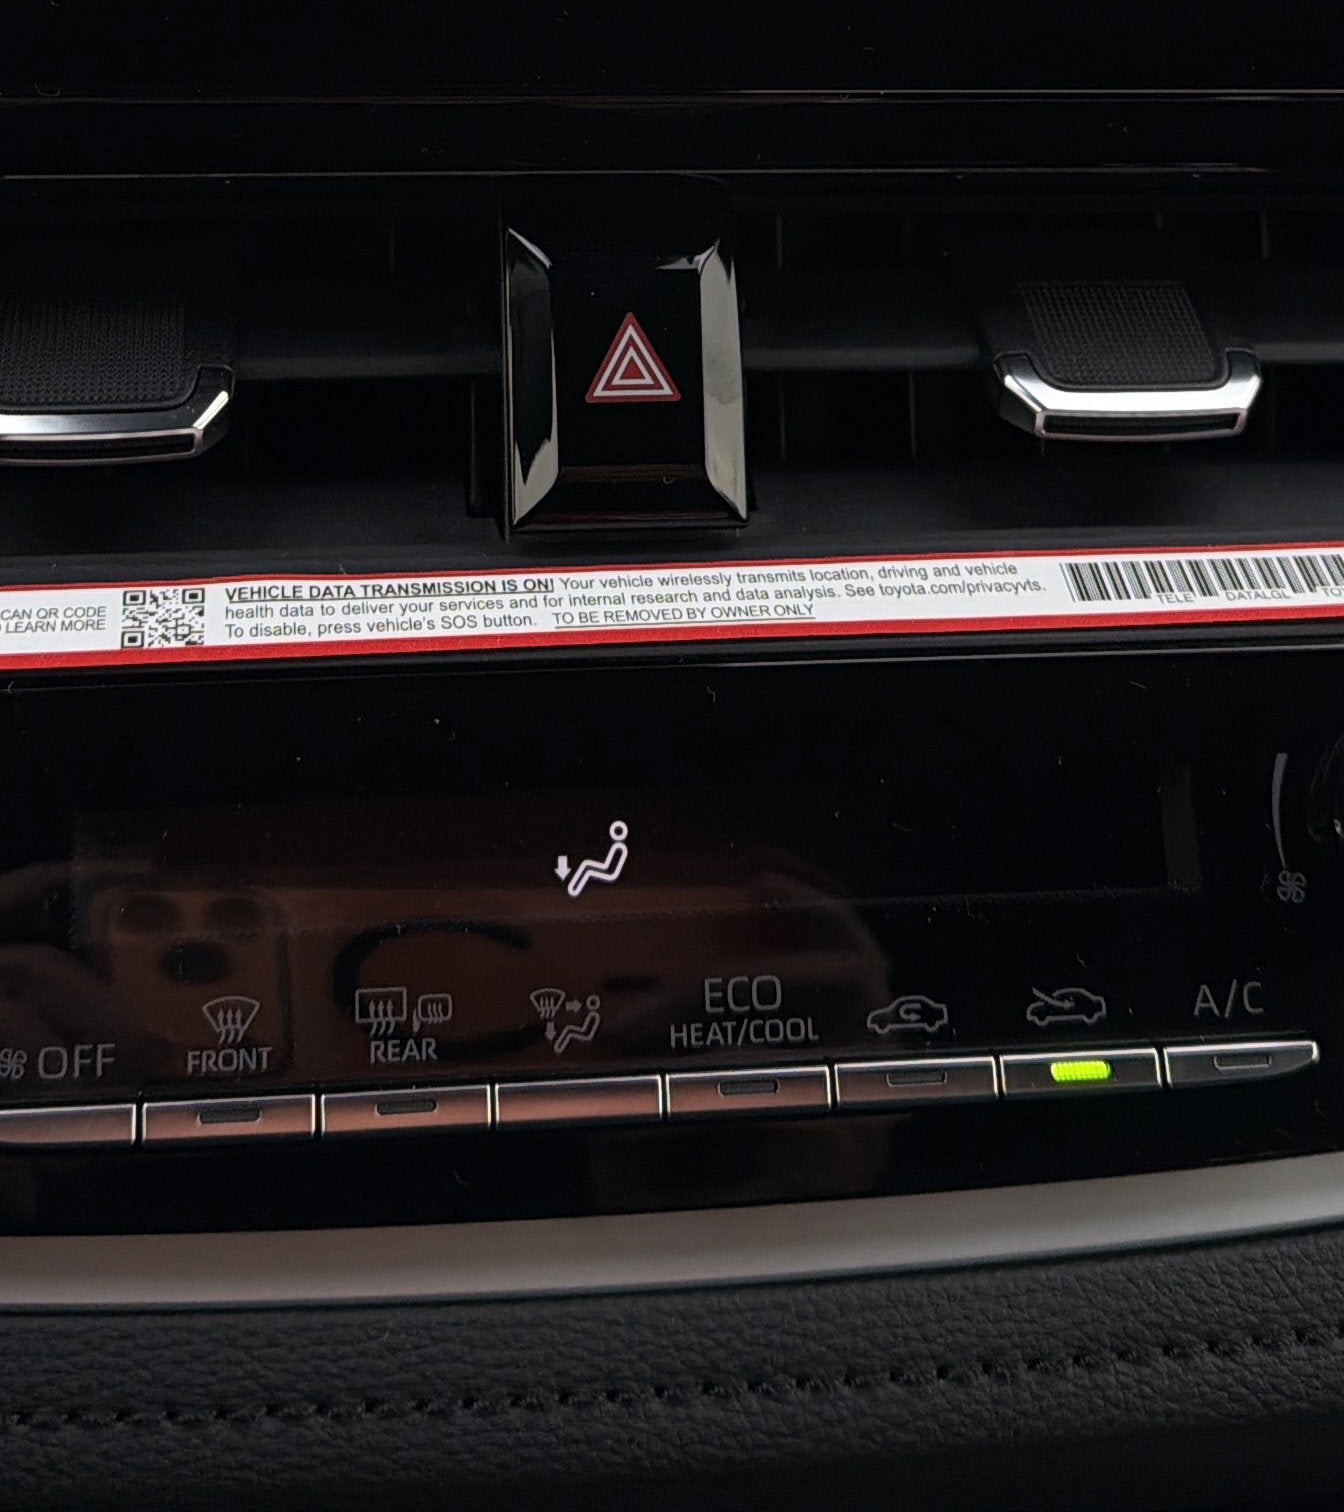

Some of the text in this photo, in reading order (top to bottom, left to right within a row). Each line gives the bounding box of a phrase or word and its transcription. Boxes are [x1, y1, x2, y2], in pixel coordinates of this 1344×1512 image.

[225, 584, 303, 601] VEHICLE
[309, 583, 356, 600] DATA
[360, 580, 496, 600] TRANSMISSION
[502, 579, 518, 593] IS
[558, 577, 595, 591] Your
[599, 575, 654, 589] vehicle
[657, 572, 732, 587] wirelessly
[736, 570, 806, 584] transmits
[809, 567, 874, 582] location,
[877, 565, 928, 580] driving
[933, 563, 961, 578] and
[964, 562, 1018, 576] vehicle
[36, 607, 59, 619] QR
[63, 606, 107, 619] CODE
[225, 604, 274, 620] health
[279, 603, 314, 618] data
[321, 603, 336, 616] to
[341, 601, 394, 615] deliver
[399, 601, 434, 616] your
[439, 597, 504, 612] services
[509, 595, 538, 609] and
[543, 594, 563, 608] for
[568, 592, 626, 607] internal
[631, 590, 698, 605] research
[702, 587, 731, 602] and
[735, 587, 769, 601] data
[774, 585, 841, 602] analysis.
[844, 583, 875, 598] See
[5, 620, 56, 634] LEARN
[60, 618, 106, 631] MORE
[225, 603, 815, 638] To disable, press vehicle's SOS button. TO BE REMOVED BY OWNER ONLY
[704, 974, 783, 1014] ECO
[1193, 978, 1265, 1018] A/C
[670, 1015, 821, 1048] HEAT/COOL
[36, 1044, 115, 1080] OFF
[186, 1046, 273, 1075] FRONT
[369, 1037, 438, 1065] REAR
